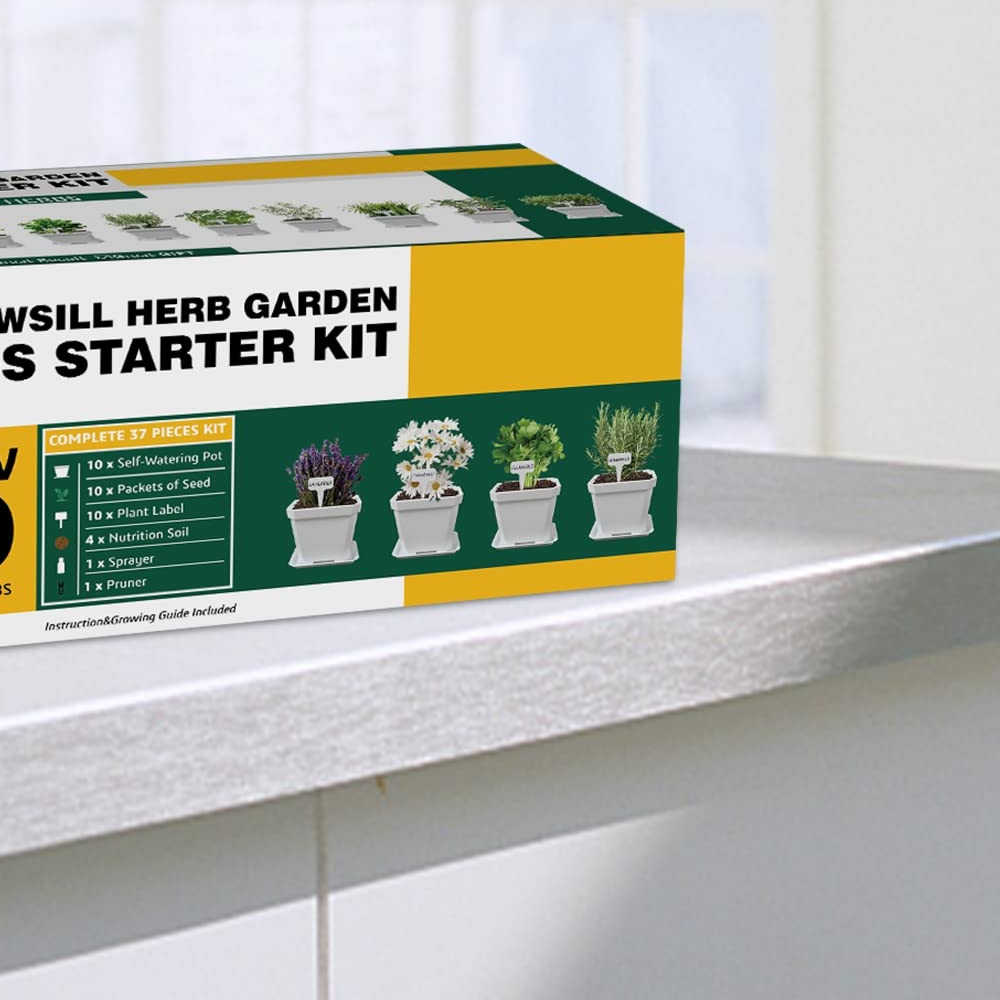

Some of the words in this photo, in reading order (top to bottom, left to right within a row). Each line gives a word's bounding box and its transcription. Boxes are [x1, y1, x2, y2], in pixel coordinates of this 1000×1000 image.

[47, 178, 110, 188] KIT
[127, 296, 231, 326] HERB
[243, 286, 397, 320] GARDEN
[54, 328, 296, 378] STARTER
[313, 322, 397, 361] KIT
[48, 430, 125, 446] COMPLETE
[129, 428, 147, 440] 37
[151, 424, 199, 439] PIECES
[203, 422, 227, 435] KIT
[87, 459, 103, 470] 10
[106, 460, 114, 469] x
[117, 452, 199, 469] Self-Watering
[202, 450, 223, 462] Pot
[87, 485, 103, 496] 10
[106, 487, 114, 495] x
[117, 480, 163, 494] Packets
[166, 478, 180, 490] of
[182, 477, 211, 490] Seed
[87, 510, 102, 521] 10
[105, 511, 114, 520] x
[117, 506, 149, 519] Plant
[152, 503, 184, 516] Label
[85, 534, 94, 545] 4
[97, 536, 105, 544] x
[109, 530, 164, 544] Nutrition
[167, 526, 189, 539] Soil
[86, 559, 93, 568] 1
[97, 560, 105, 568] x
[108, 555, 155, 568] Sprayer
[84, 582, 90, 592] 1
[94, 583, 103, 591] x
[107, 578, 147, 590] Pruner
[44, 612, 156, 631] Instruction&Growing
[158, 609, 189, 620] Guide
[192, 603, 237, 616] Included
